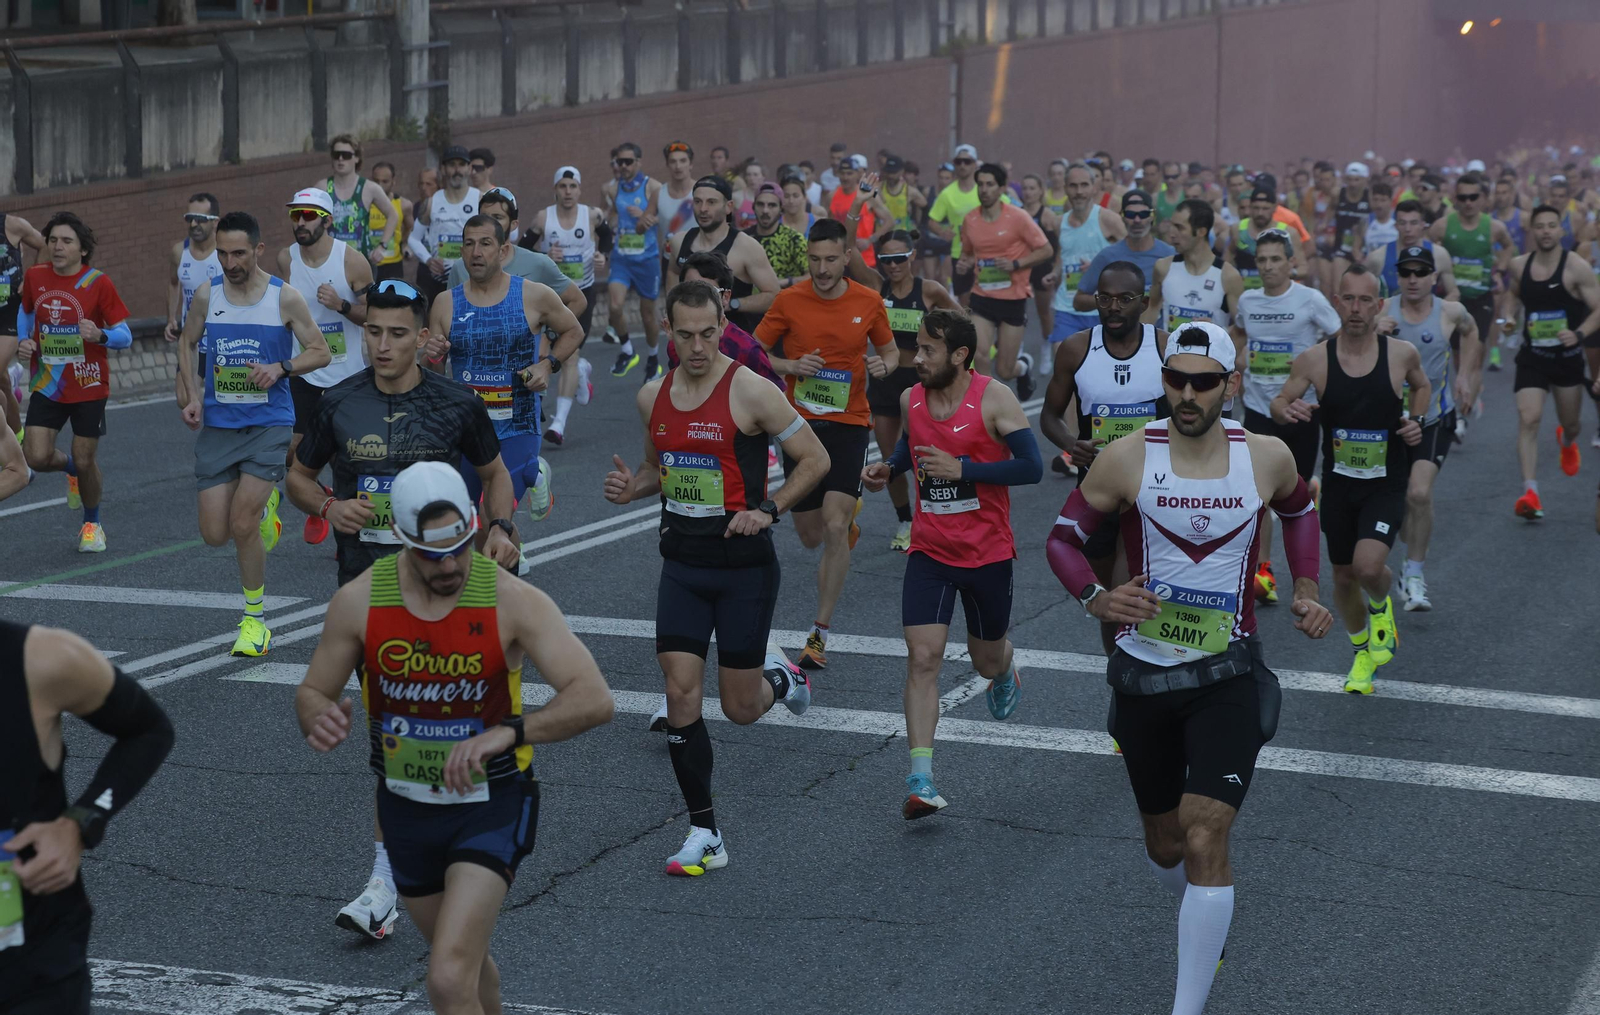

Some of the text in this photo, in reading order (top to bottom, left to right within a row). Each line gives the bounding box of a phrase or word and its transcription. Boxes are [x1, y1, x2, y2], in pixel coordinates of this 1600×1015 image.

[44, 346, 80, 355] ANTONIO
[1114, 364, 1131, 372] SCUF
[815, 370, 846, 380] ZURICH
[814, 383, 830, 393] 1896
[804, 391, 836, 406] ANGEL
[1113, 407, 1148, 415] ZURICH
[1114, 423, 1133, 431] 2389
[688, 430, 724, 441] PICORNELL
[1351, 446, 1368, 454] 1873
[678, 456, 714, 466] ZURICH
[1350, 456, 1368, 467] RIK
[680, 475, 699, 484] 1937
[674, 486, 705, 501] RAÚL
[929, 487, 958, 500] SEBY
[1156, 495, 1244, 509] BORDEAUX
[1177, 591, 1226, 607] ZURICH
[1174, 611, 1201, 625] 1380
[1159, 622, 1208, 647] SAMY
[377, 639, 483, 678] Gorras
[379, 674, 489, 702] runners
[414, 723, 471, 737] ZURICH
[417, 749, 446, 762] 1871
